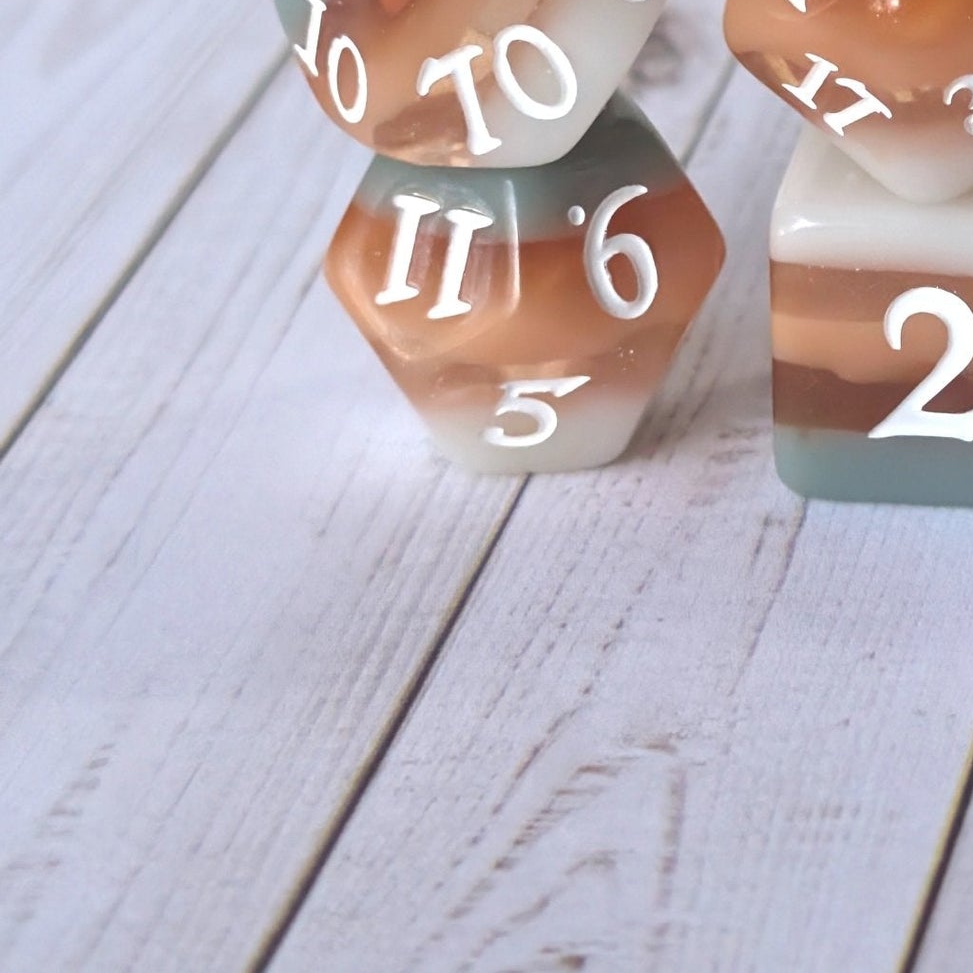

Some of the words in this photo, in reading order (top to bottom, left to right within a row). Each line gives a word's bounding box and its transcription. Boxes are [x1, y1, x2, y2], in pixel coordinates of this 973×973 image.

[416, 24, 578, 156] 70
[782, 52, 893, 137] 17
[375, 193, 494, 320] 11
[484, 375, 591, 447] 5
